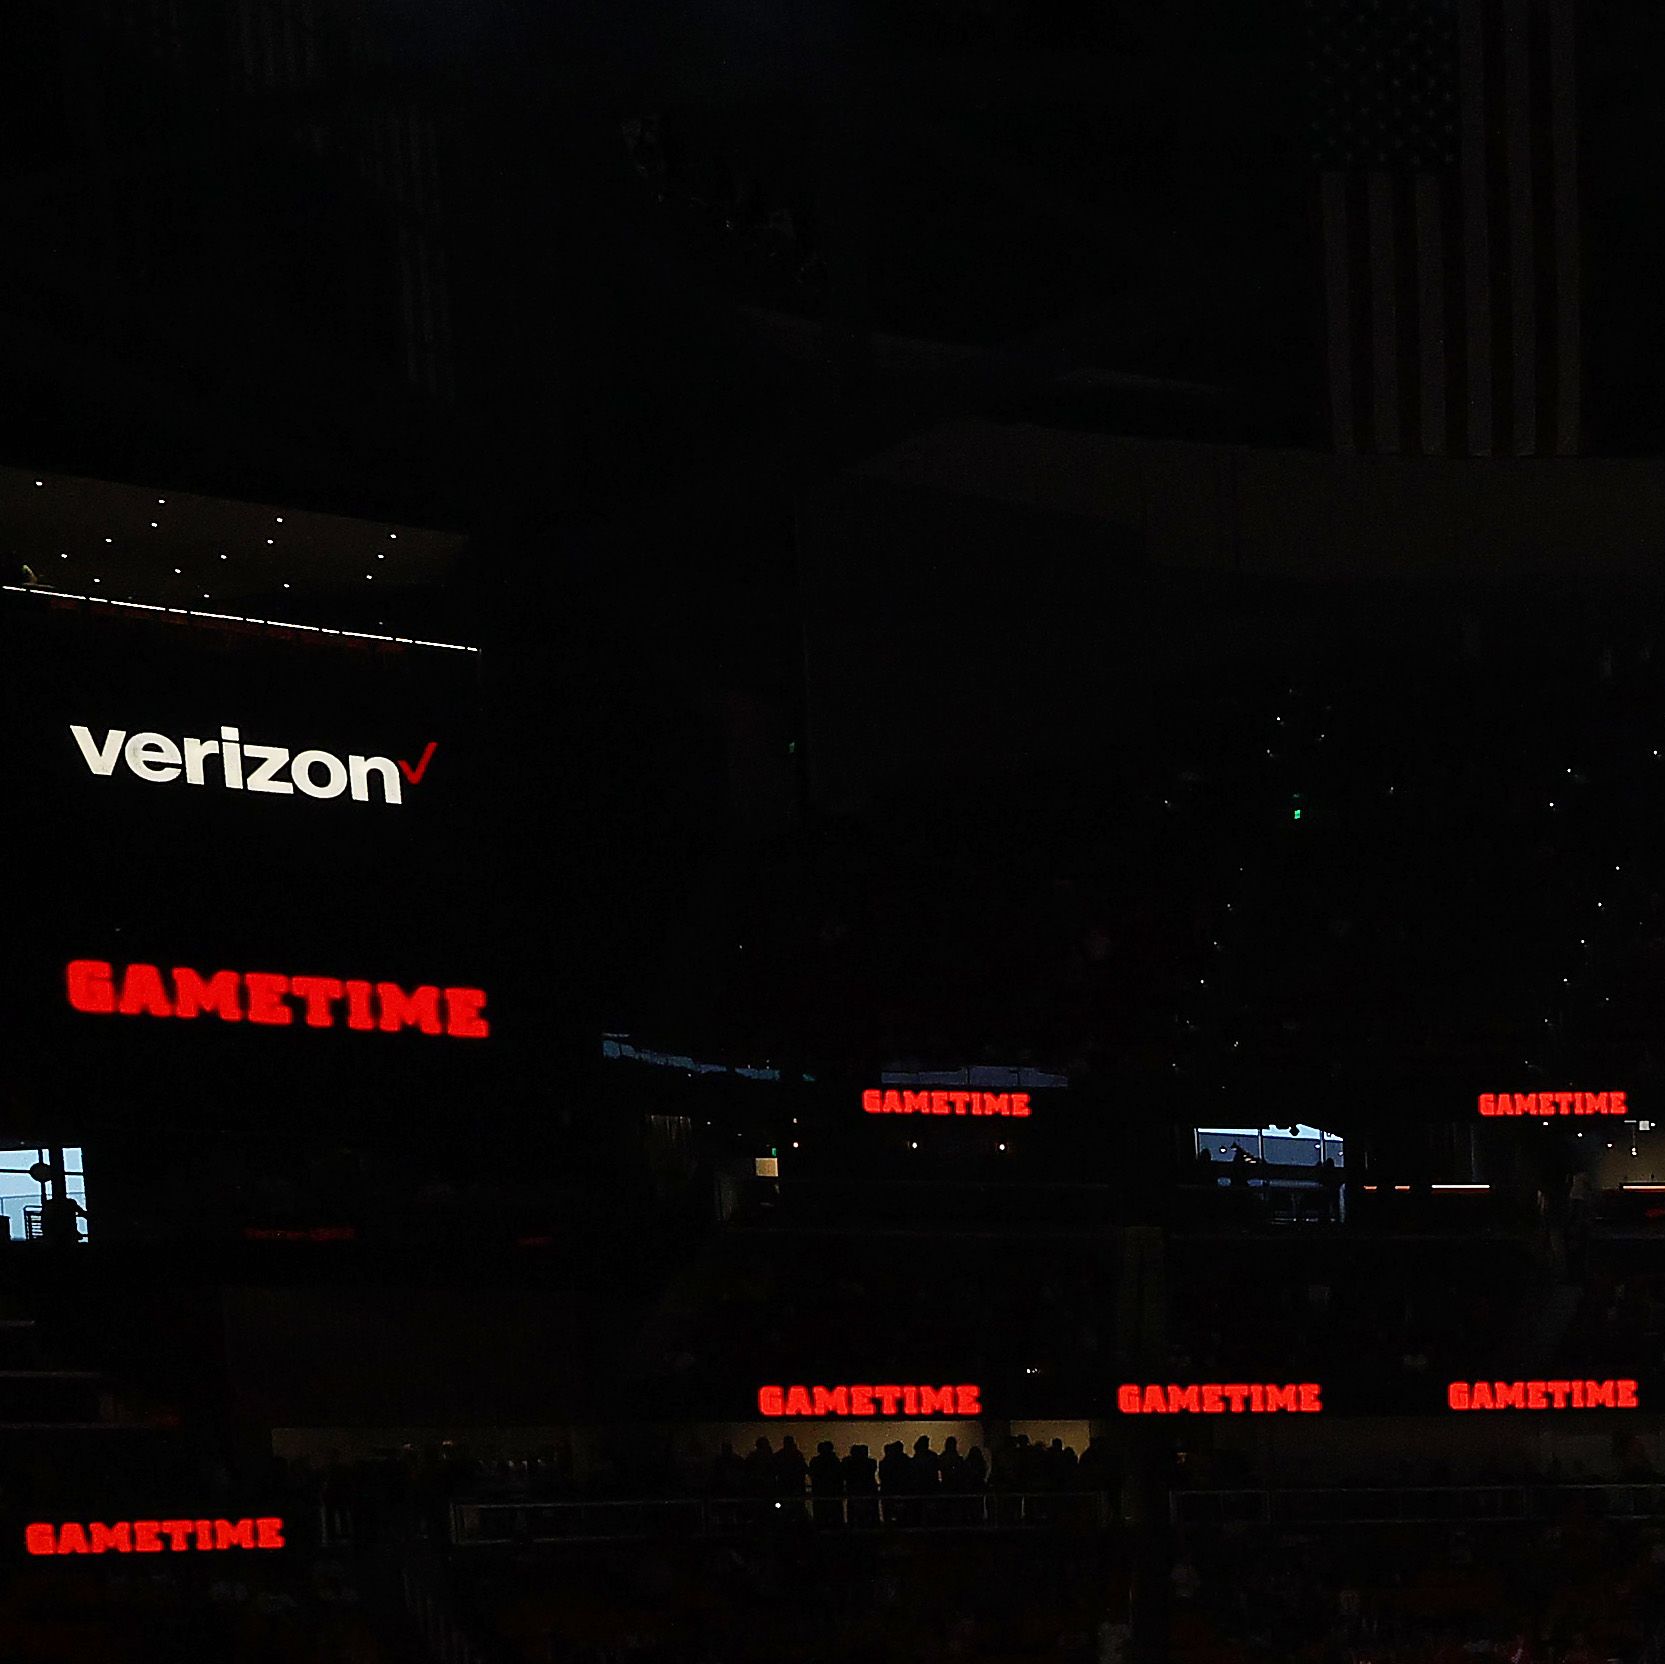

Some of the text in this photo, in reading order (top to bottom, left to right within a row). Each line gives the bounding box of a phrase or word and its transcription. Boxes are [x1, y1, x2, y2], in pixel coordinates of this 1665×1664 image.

[70, 725, 402, 804] verizon
[67, 960, 488, 1038] GAMETIME
[862, 1089, 1031, 1117] GAMETIME
[1478, 1091, 1628, 1116] GAMETIME
[758, 1385, 981, 1416] GAMETIME
[1118, 1383, 1322, 1413] GAMETIME
[1448, 1380, 1638, 1410] GAMETIME
[26, 1518, 284, 1555] GAMETIME
